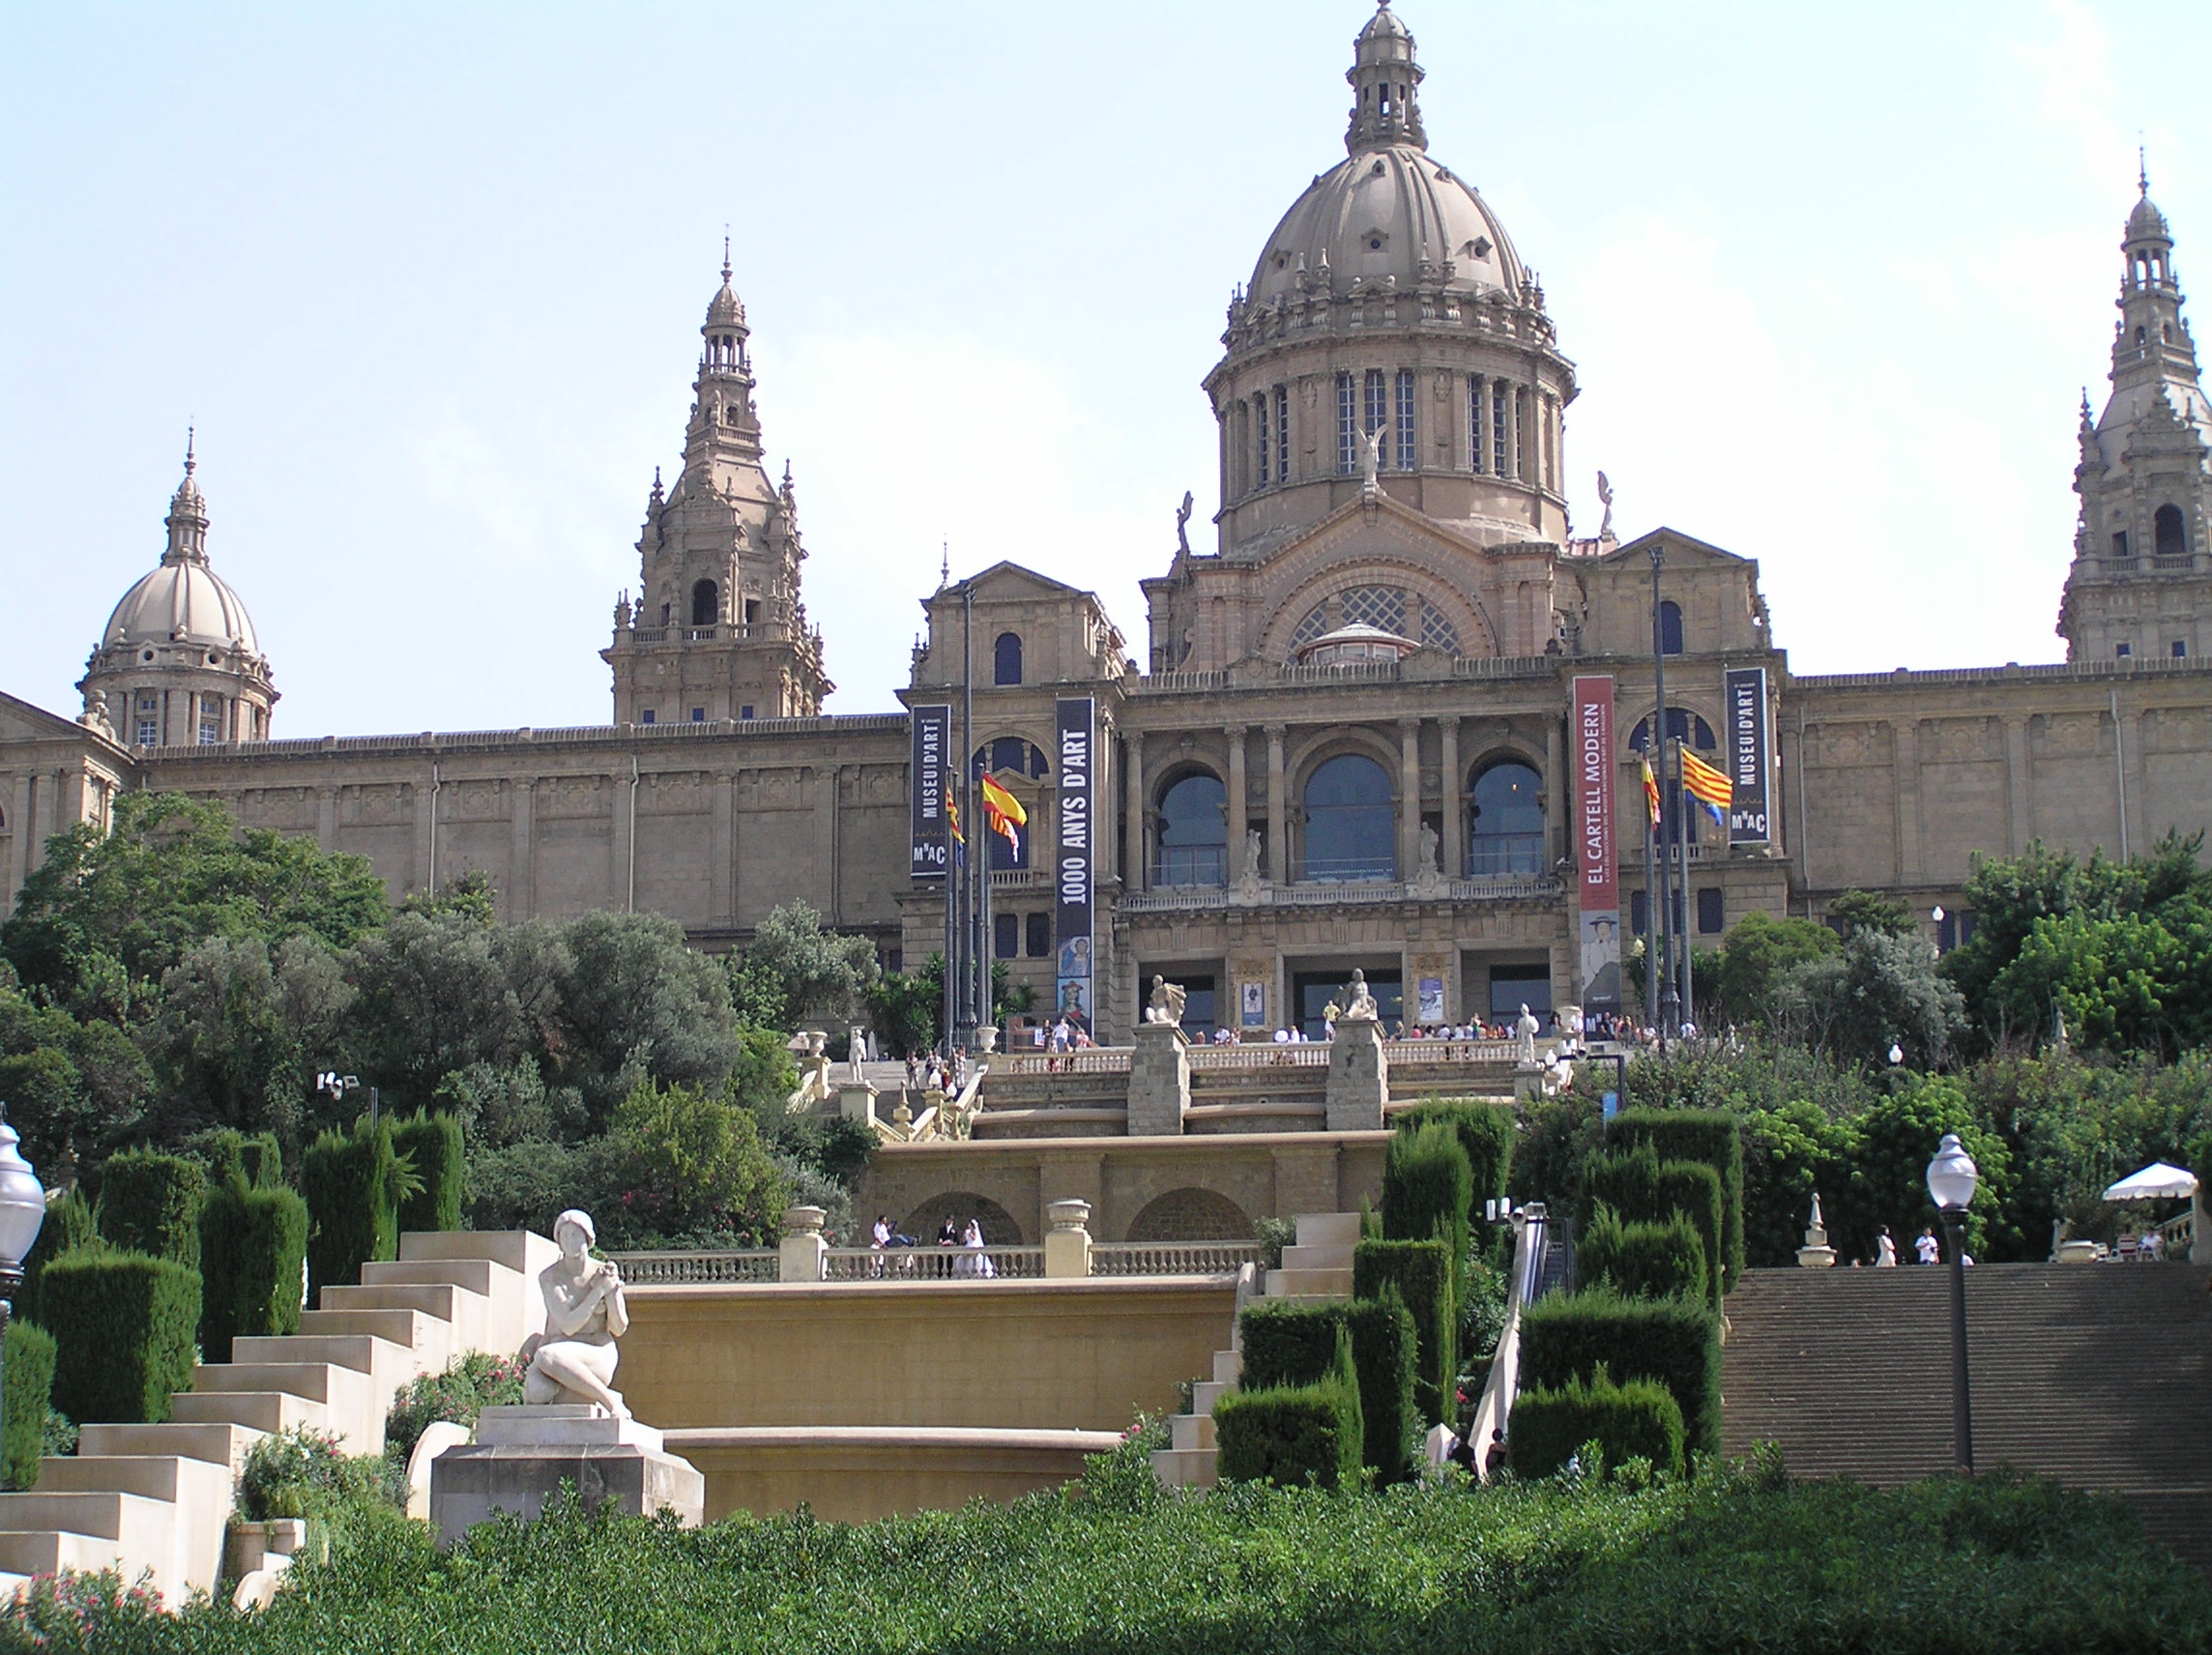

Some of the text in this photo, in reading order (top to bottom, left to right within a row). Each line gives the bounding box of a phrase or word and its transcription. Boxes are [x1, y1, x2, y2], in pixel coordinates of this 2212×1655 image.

[1737, 689, 1754, 729] D'ART
[923, 724, 938, 764] D'ART
[1739, 737, 1756, 785] MUSEU
[922, 770, 938, 818] MUSEU
[1584, 704, 1603, 884] EL CARTELL MODERN
[1062, 729, 1087, 905] 1000 ANYS D'ART
[1732, 810, 1765, 833] MNAC
[914, 842, 946, 864] MNAC
